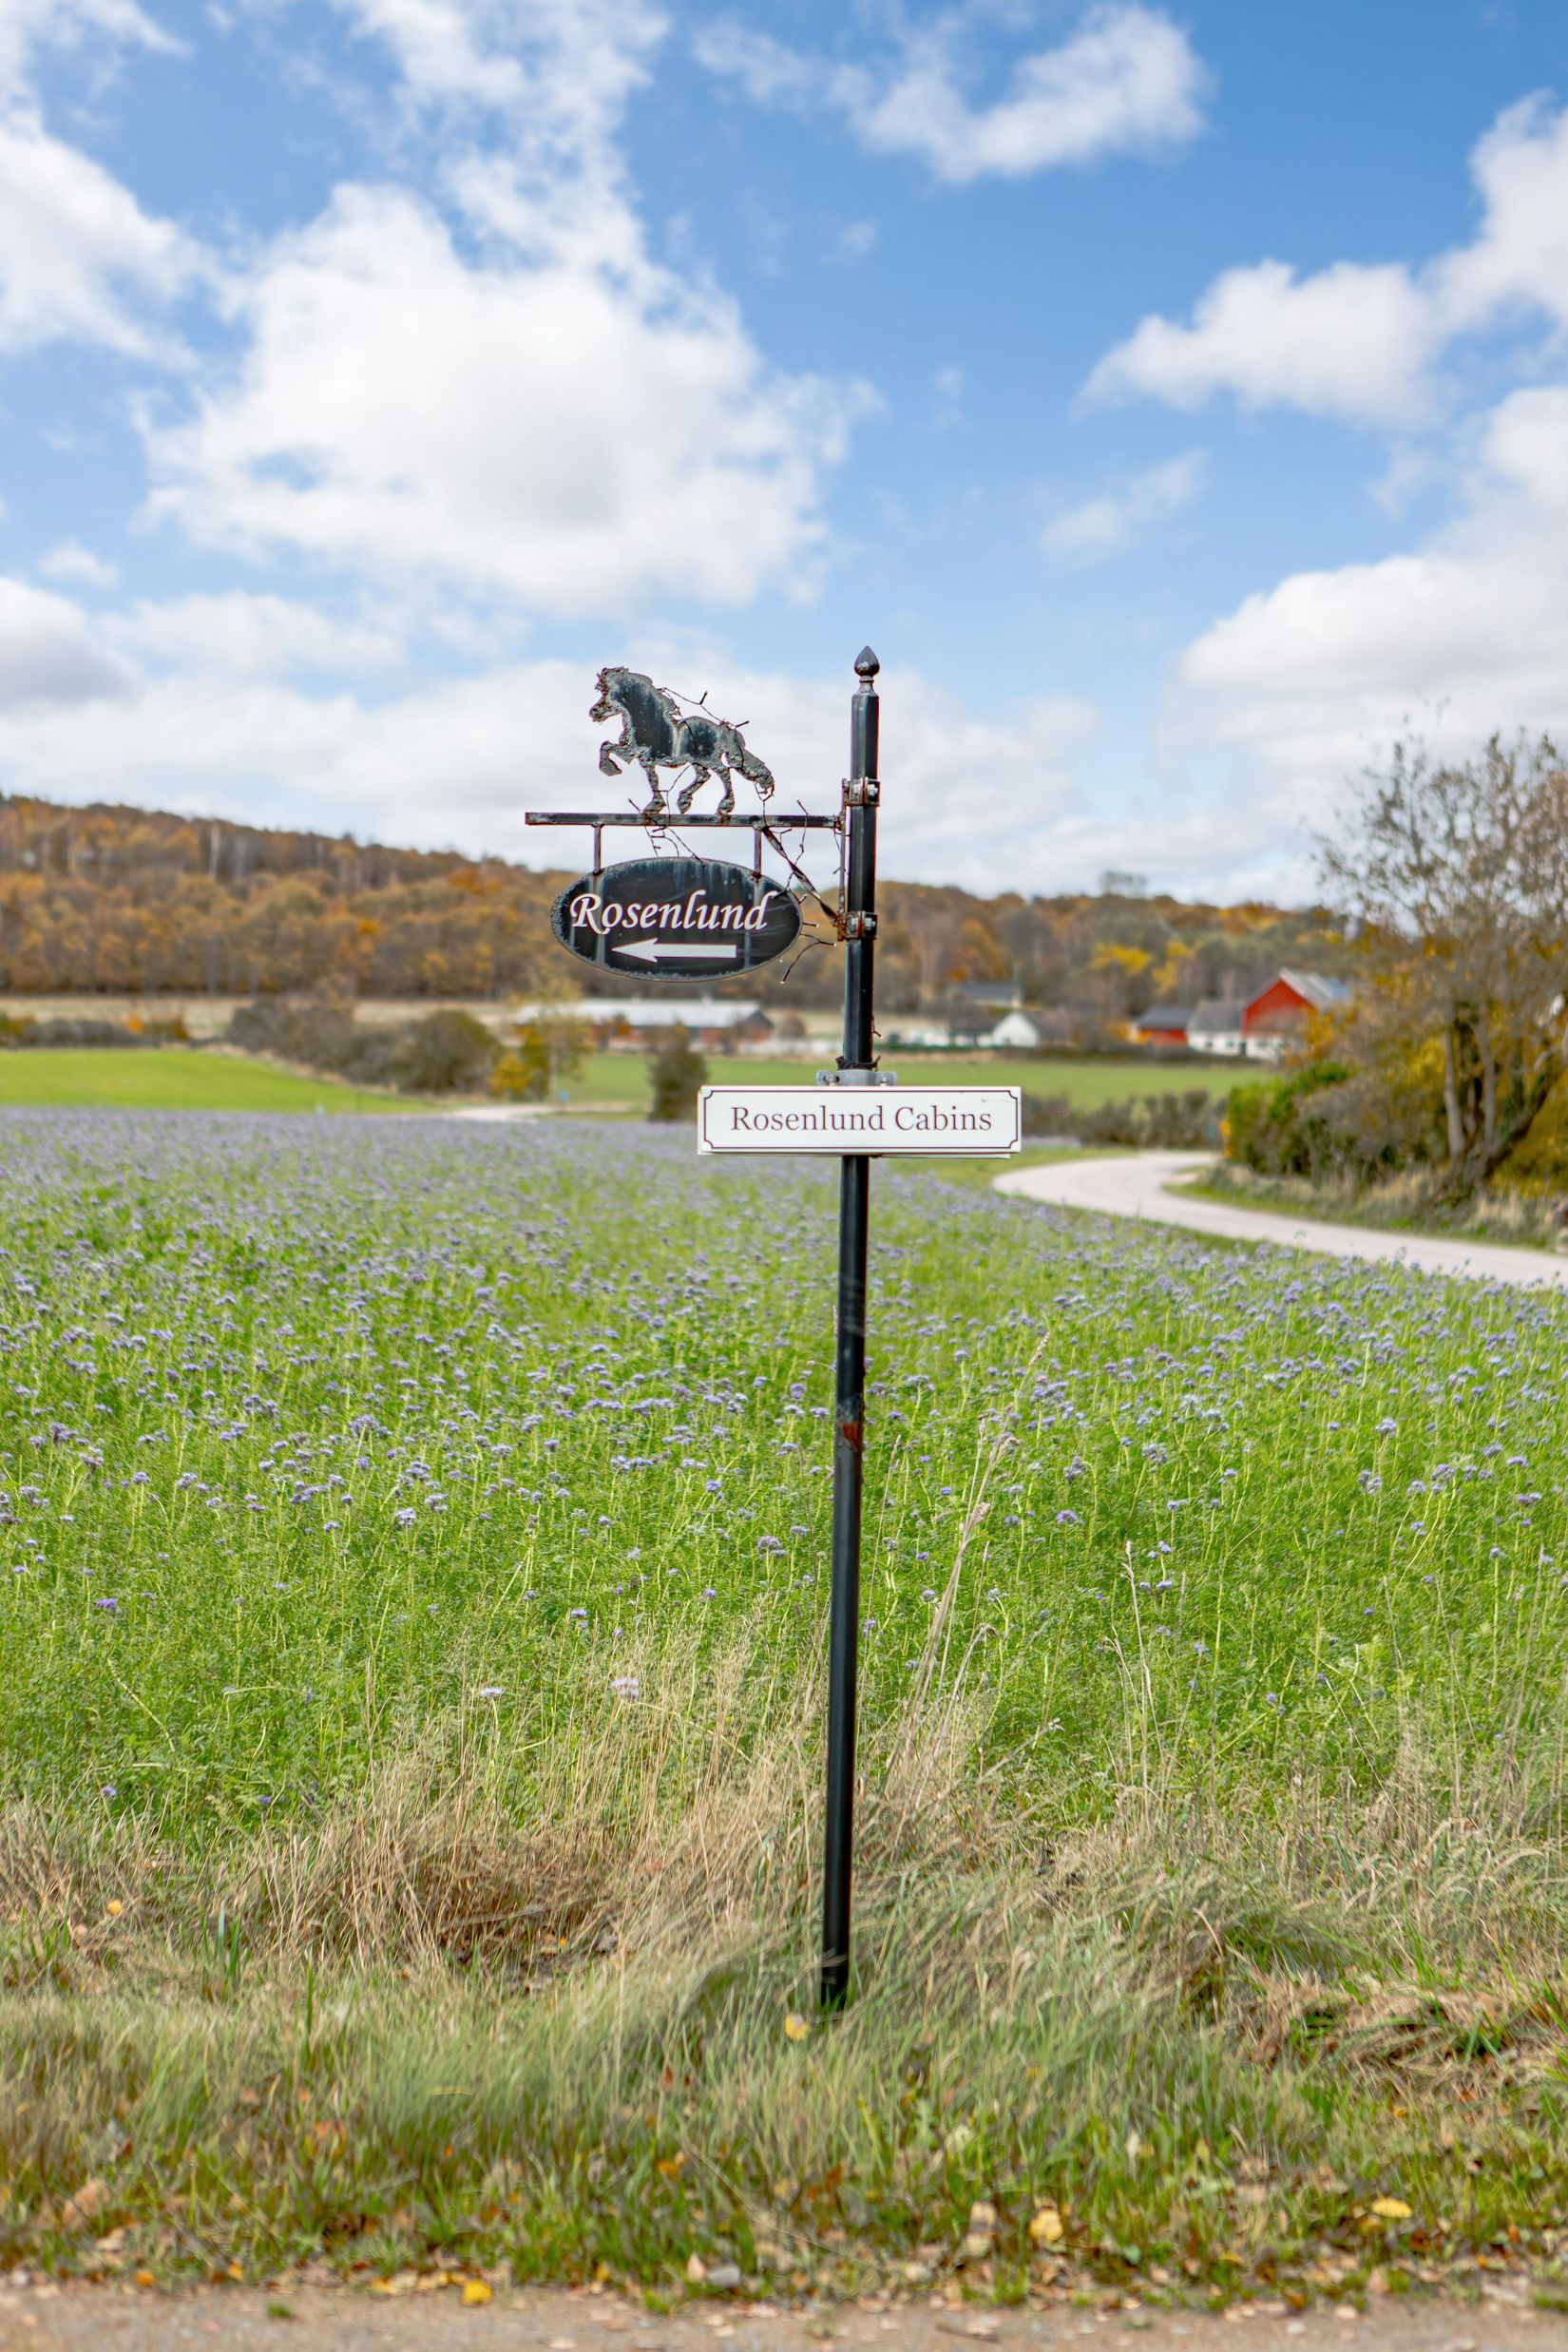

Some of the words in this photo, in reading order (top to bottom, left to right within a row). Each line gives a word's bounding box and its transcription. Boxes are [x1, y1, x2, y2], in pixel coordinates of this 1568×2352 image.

[570, 889, 778, 935] Rosenlund
[730, 1105, 886, 1132] Rosenlund
[894, 1105, 992, 1132] Cabins
